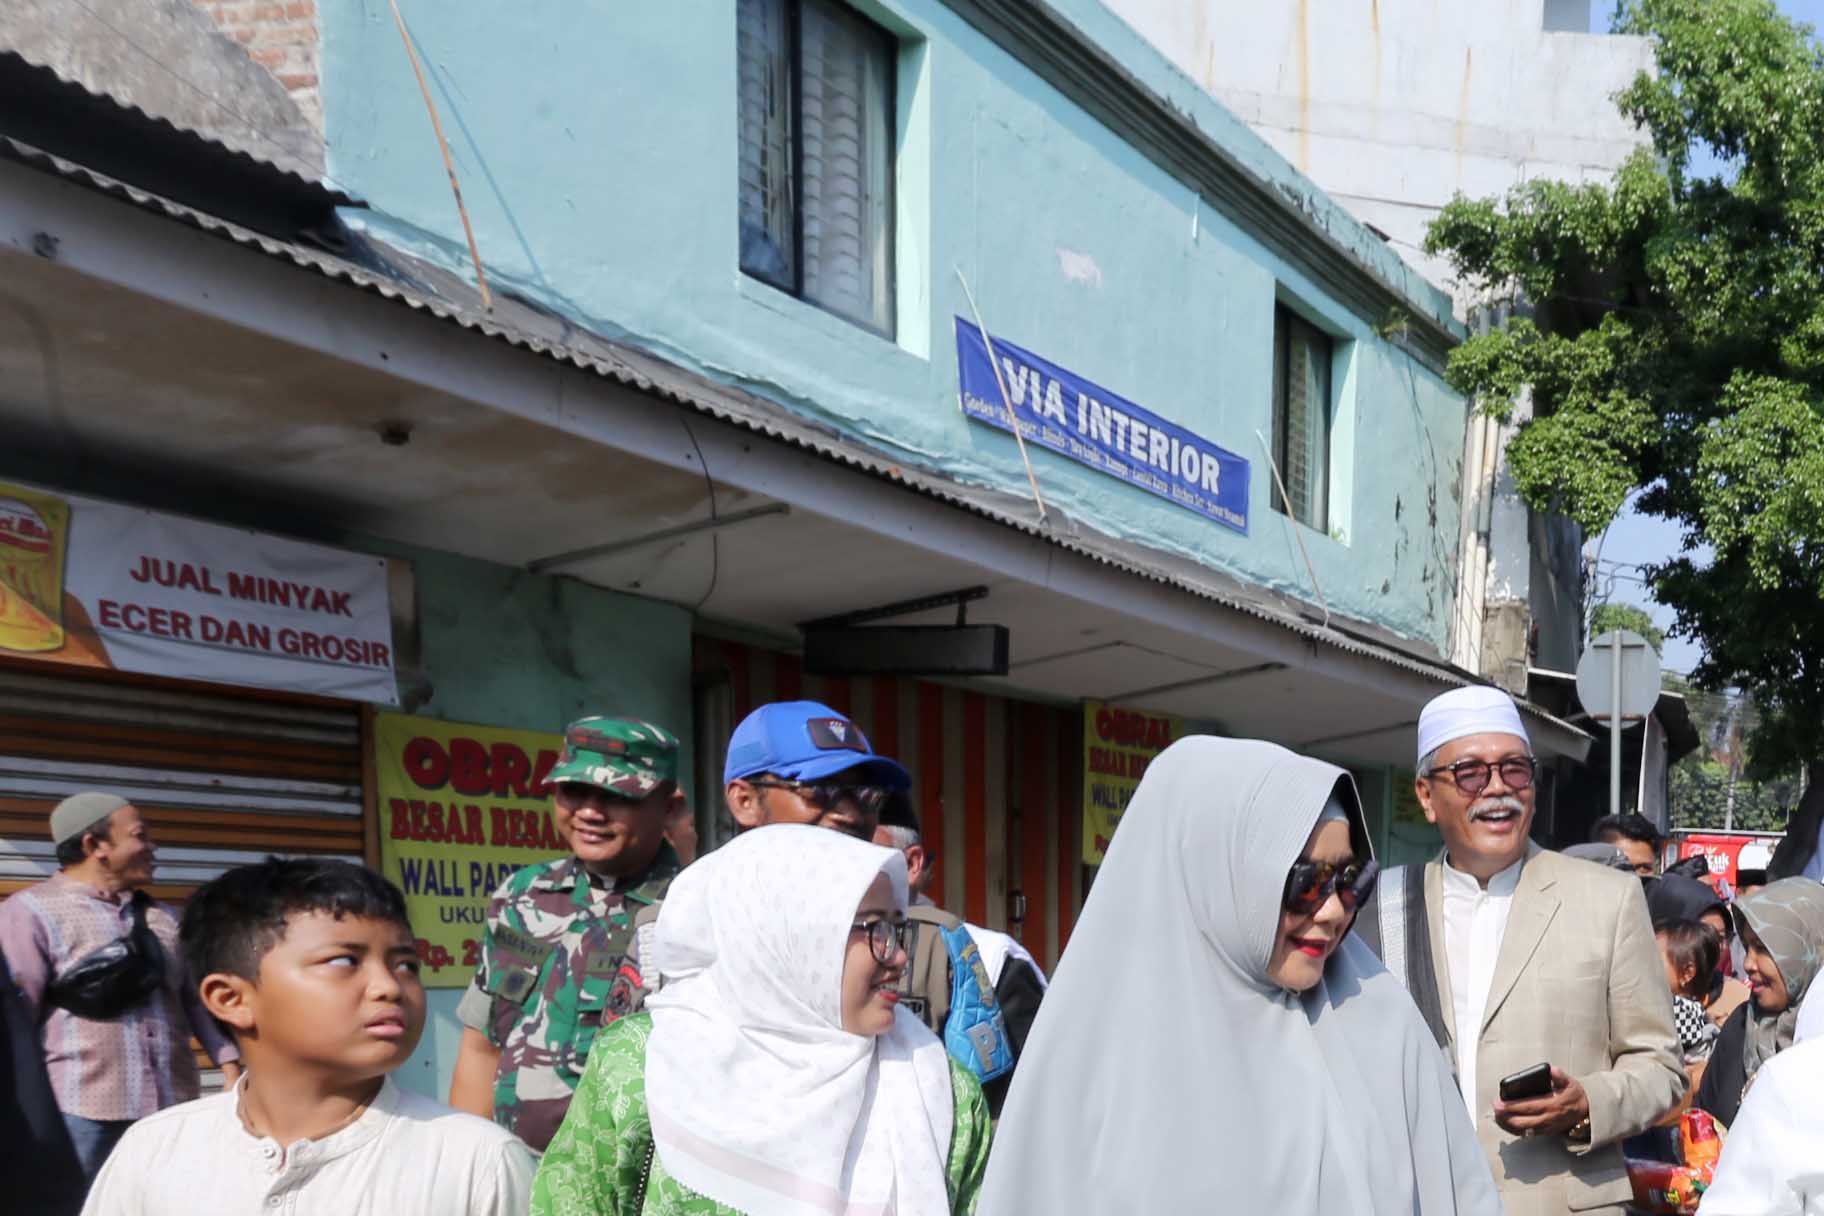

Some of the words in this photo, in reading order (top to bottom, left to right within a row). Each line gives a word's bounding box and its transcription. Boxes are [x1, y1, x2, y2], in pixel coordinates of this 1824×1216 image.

[1002, 356, 1067, 426] VIA
[1077, 392, 1221, 496] INTERIOR
[130, 556, 222, 596] JUAL
[227, 572, 353, 617] MINYAK
[98, 599, 193, 641] ECER
[199, 614, 271, 650] DAN
[277, 628, 391, 667] GROSIR
[403, 736, 560, 800] OBRA
[389, 797, 487, 846] BESAR
[490, 806, 572, 851] BESA
[399, 857, 465, 898] WALL
[440, 905, 486, 925] UKU
